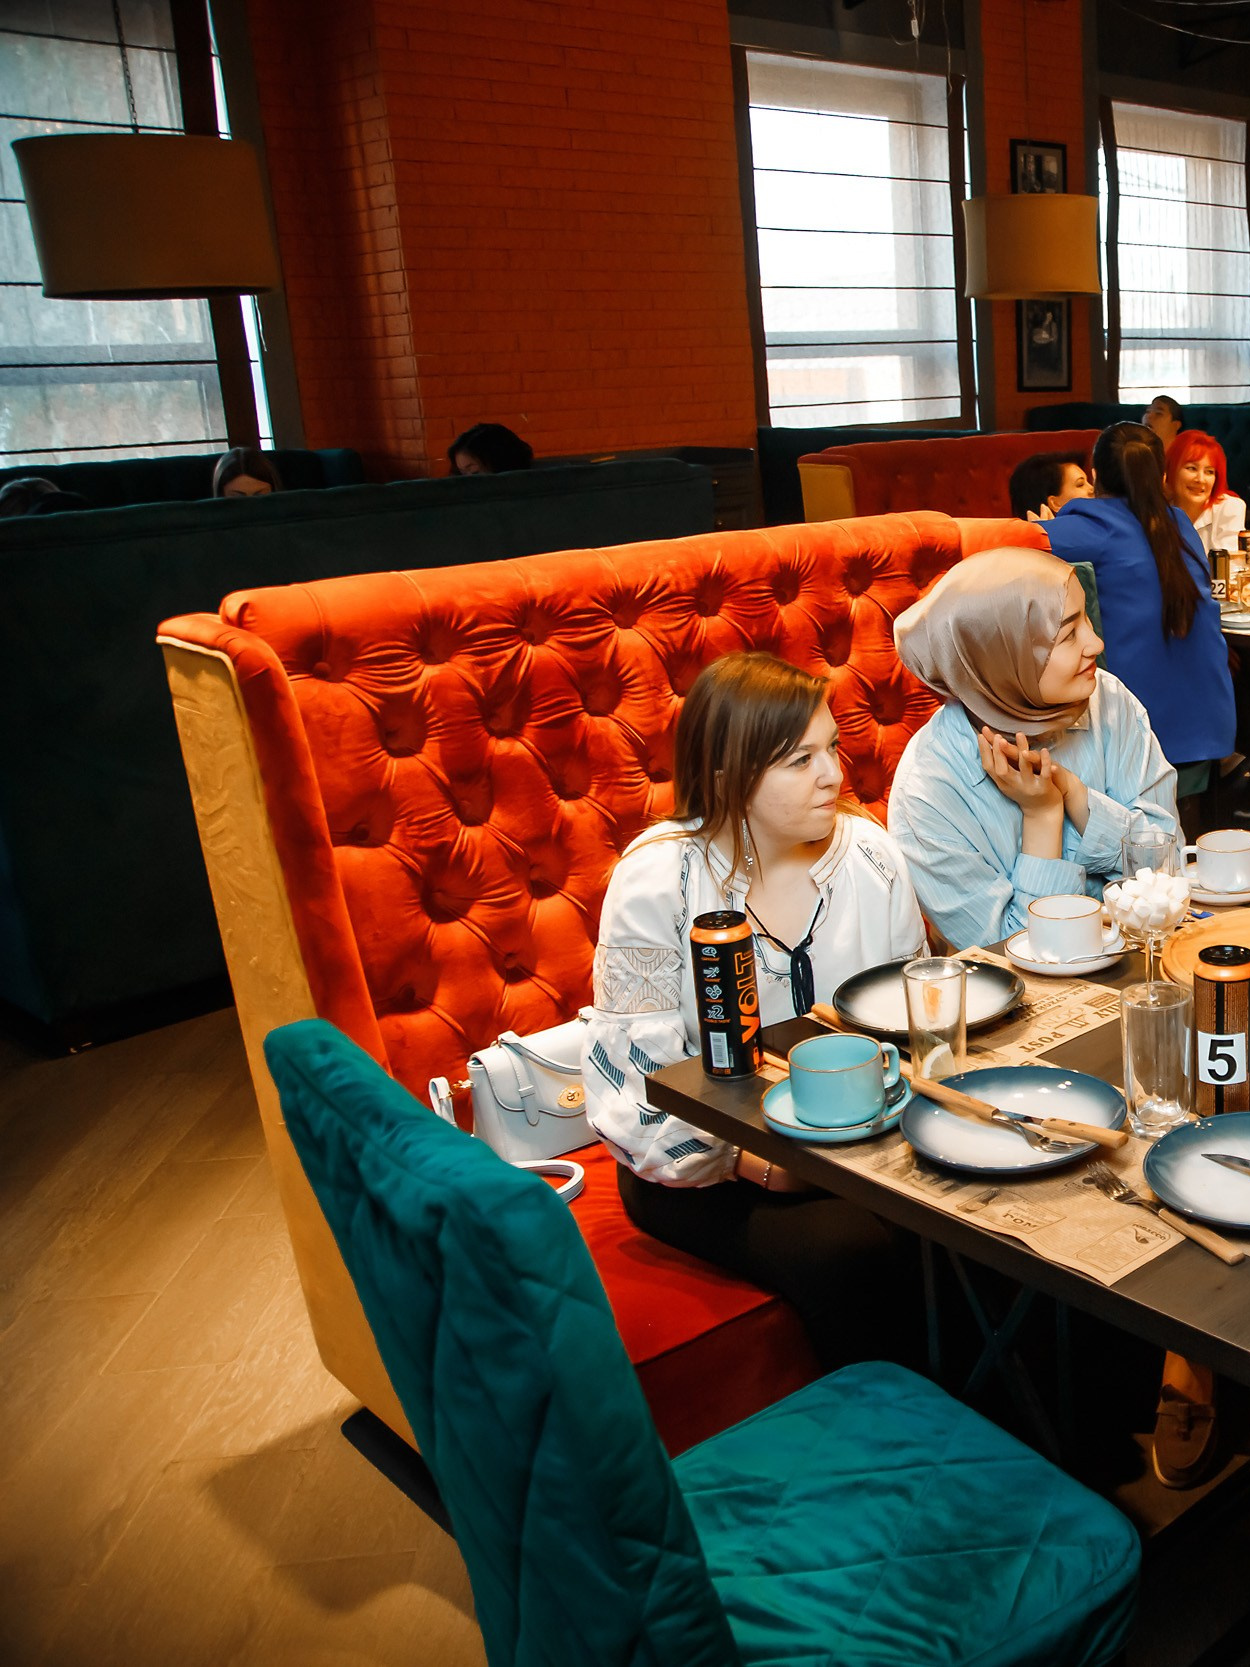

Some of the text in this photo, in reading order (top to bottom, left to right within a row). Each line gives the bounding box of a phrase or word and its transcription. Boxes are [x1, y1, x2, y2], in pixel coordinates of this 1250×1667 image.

[1211, 582, 1225, 594] 22
[734, 951, 760, 1044] VOLT
[1019, 999, 1121, 1053] AILY POST
[1208, 1039, 1237, 1082] 5
